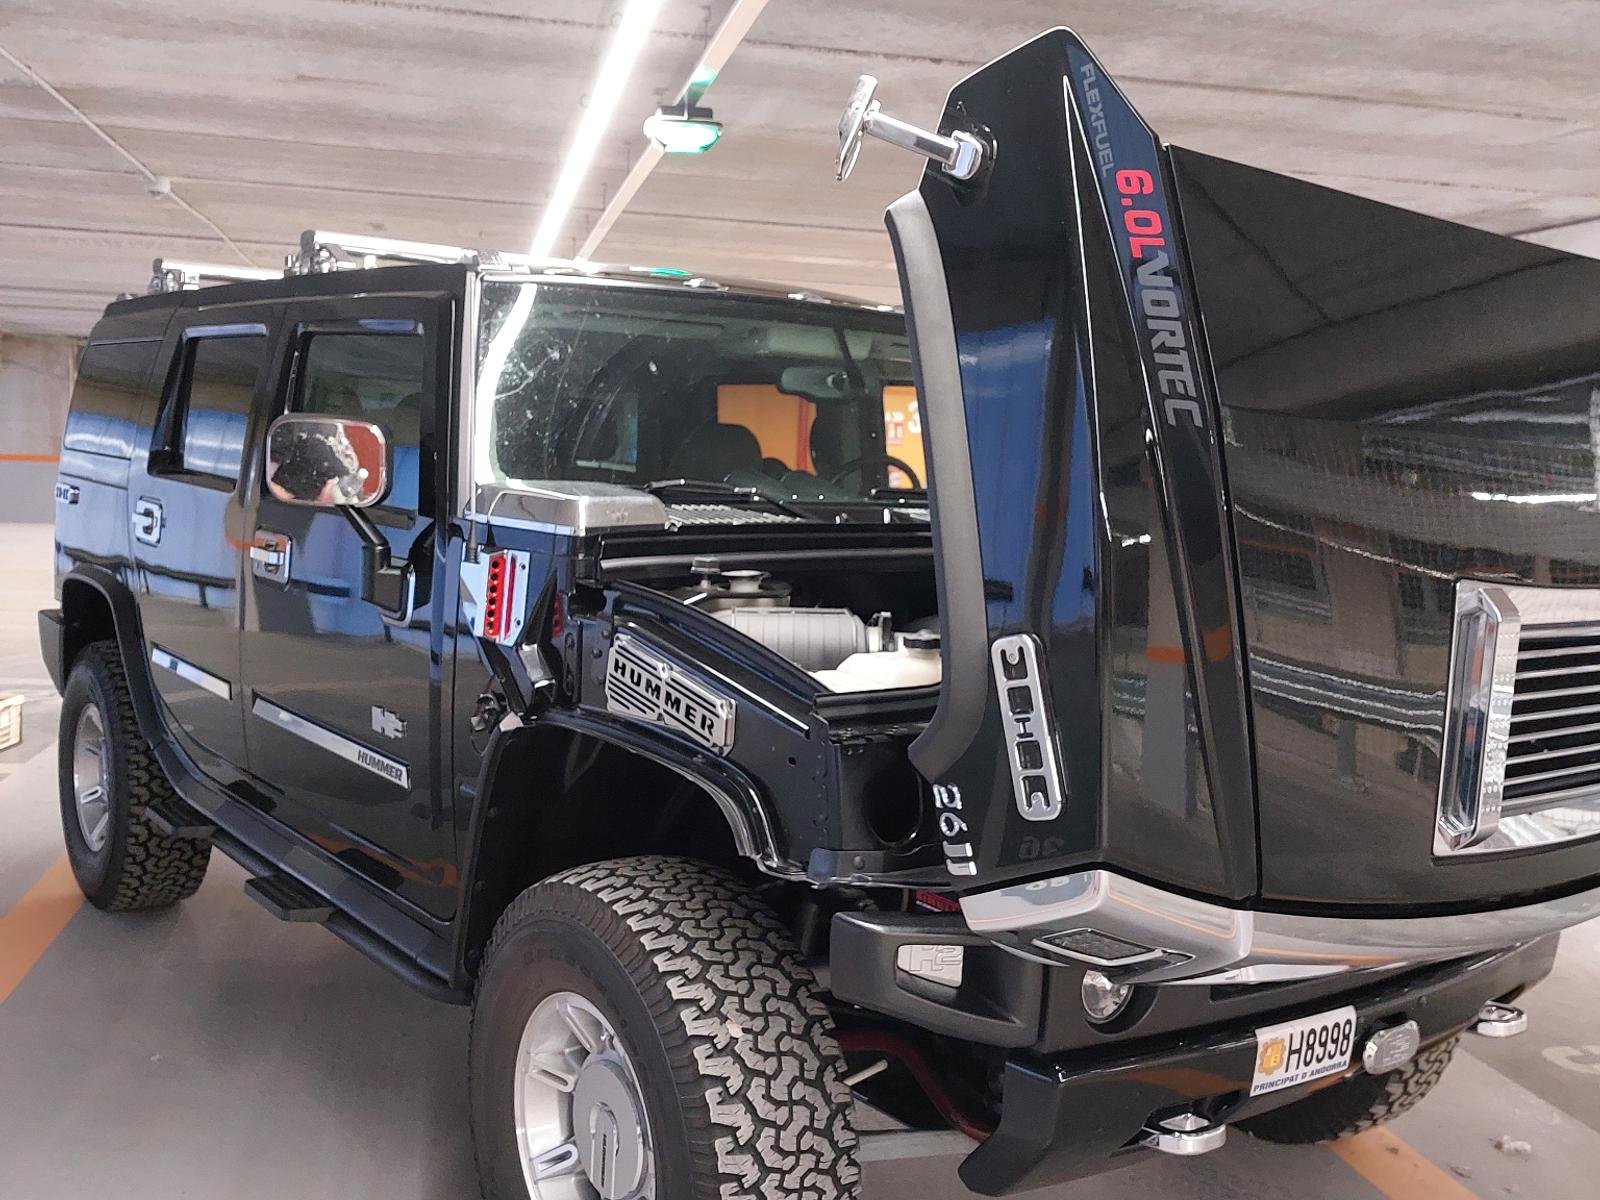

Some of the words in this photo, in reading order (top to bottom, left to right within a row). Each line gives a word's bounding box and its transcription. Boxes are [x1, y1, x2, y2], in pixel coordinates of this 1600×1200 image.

[1080, 63, 1117, 178] FLEXFUEL
[1115, 168, 1165, 259] 6.0L
[1136, 250, 1204, 428] VORTEC
[614, 657, 715, 737] HUMMER
[357, 749, 403, 782] HUMMER
[1253, 1074, 1299, 1092] PRINCIPAT
[1285, 1018, 1353, 1073] H8998
